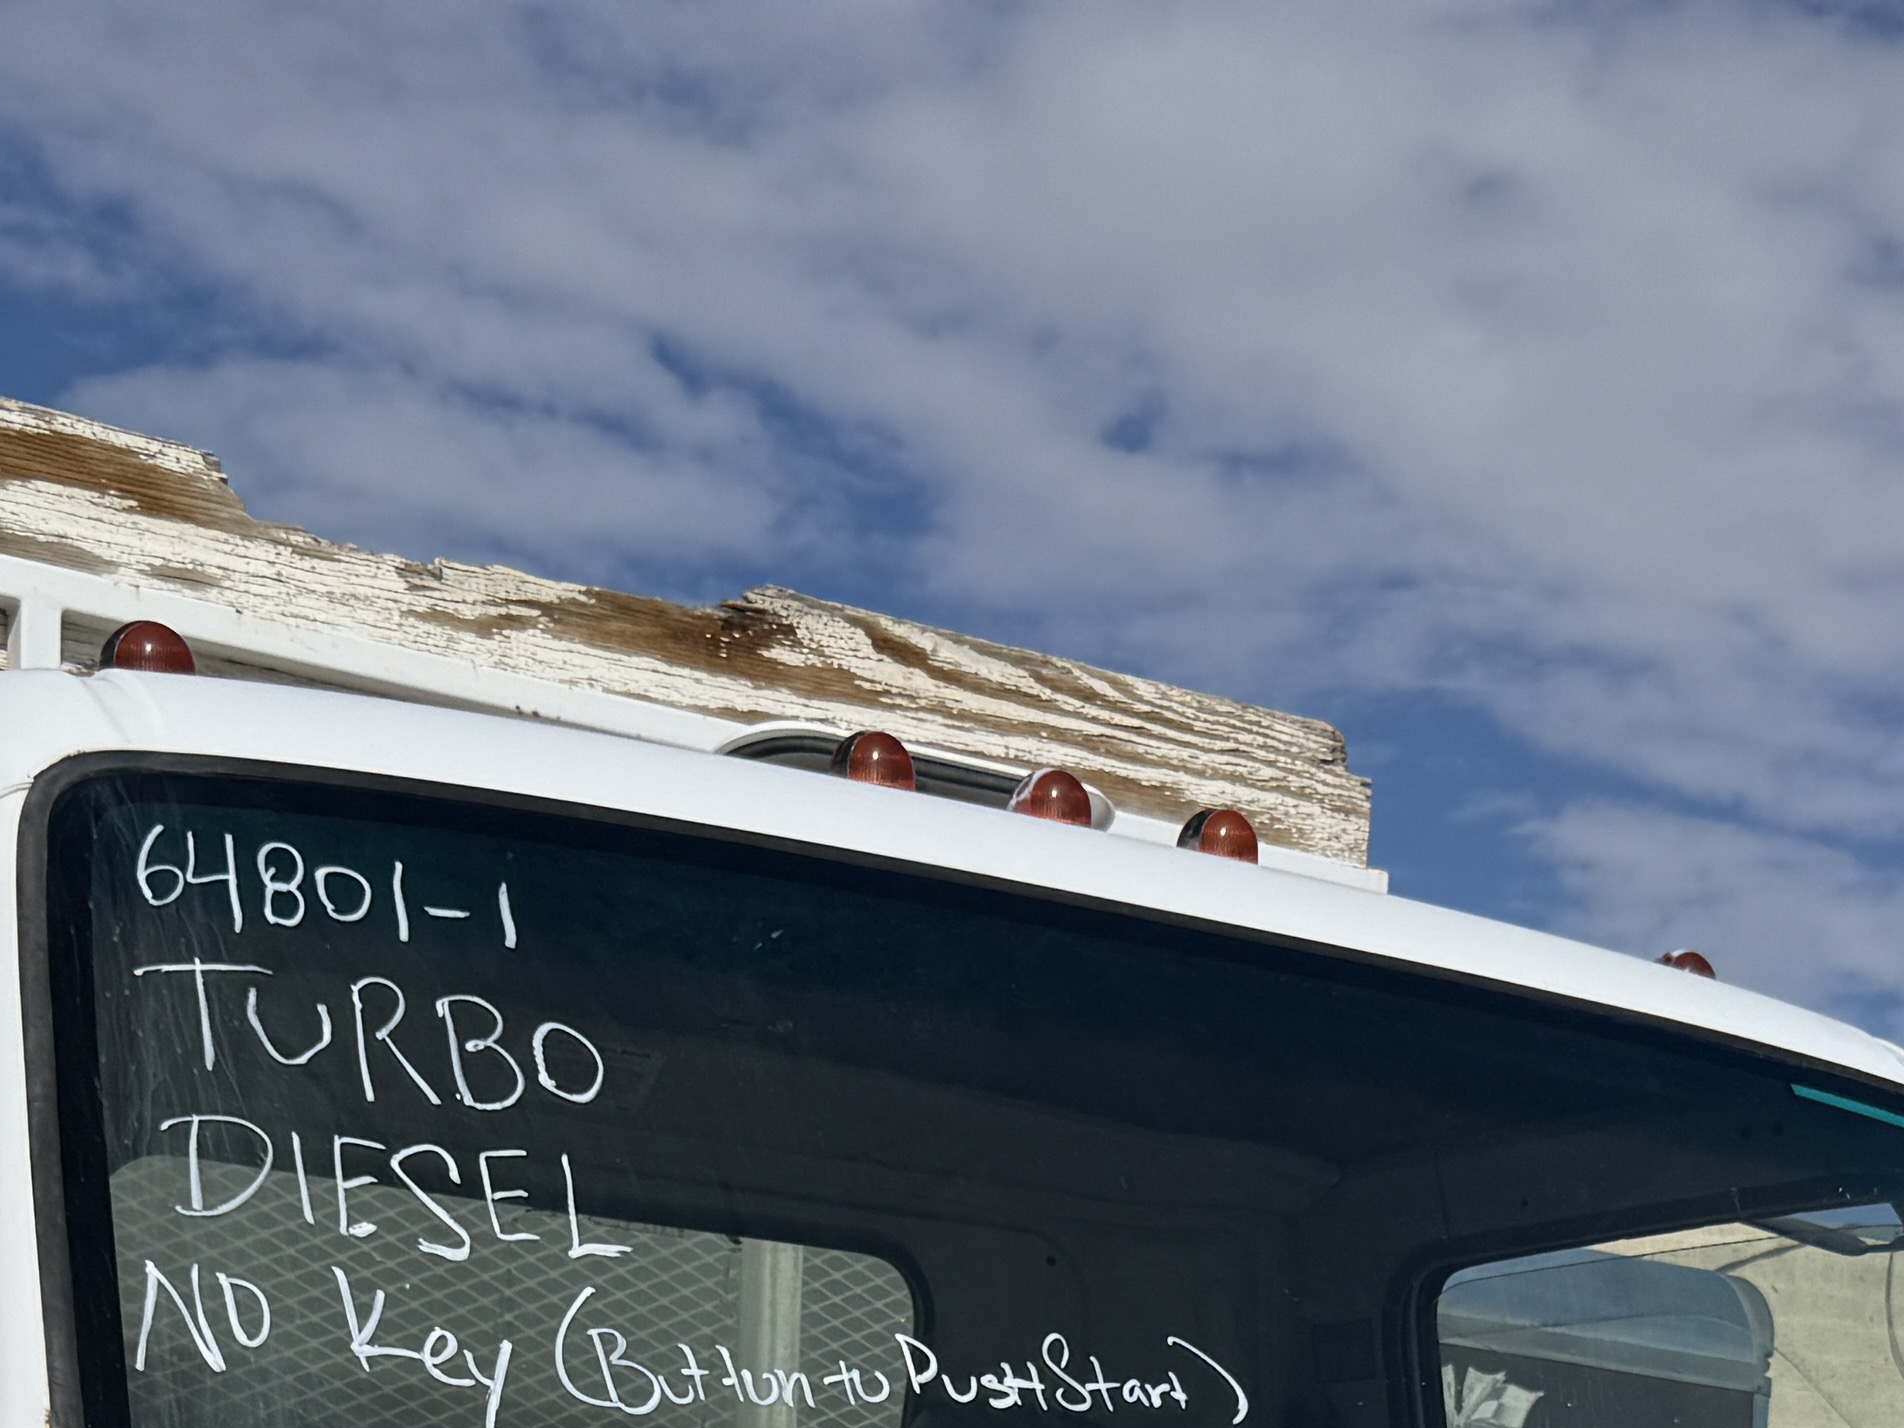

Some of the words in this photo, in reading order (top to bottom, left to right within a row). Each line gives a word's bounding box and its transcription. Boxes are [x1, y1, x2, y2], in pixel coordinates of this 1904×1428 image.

[137, 823, 520, 949] 64801-1
[133, 956, 605, 1110] TURBO
[160, 1113, 633, 1260] DIESEL
